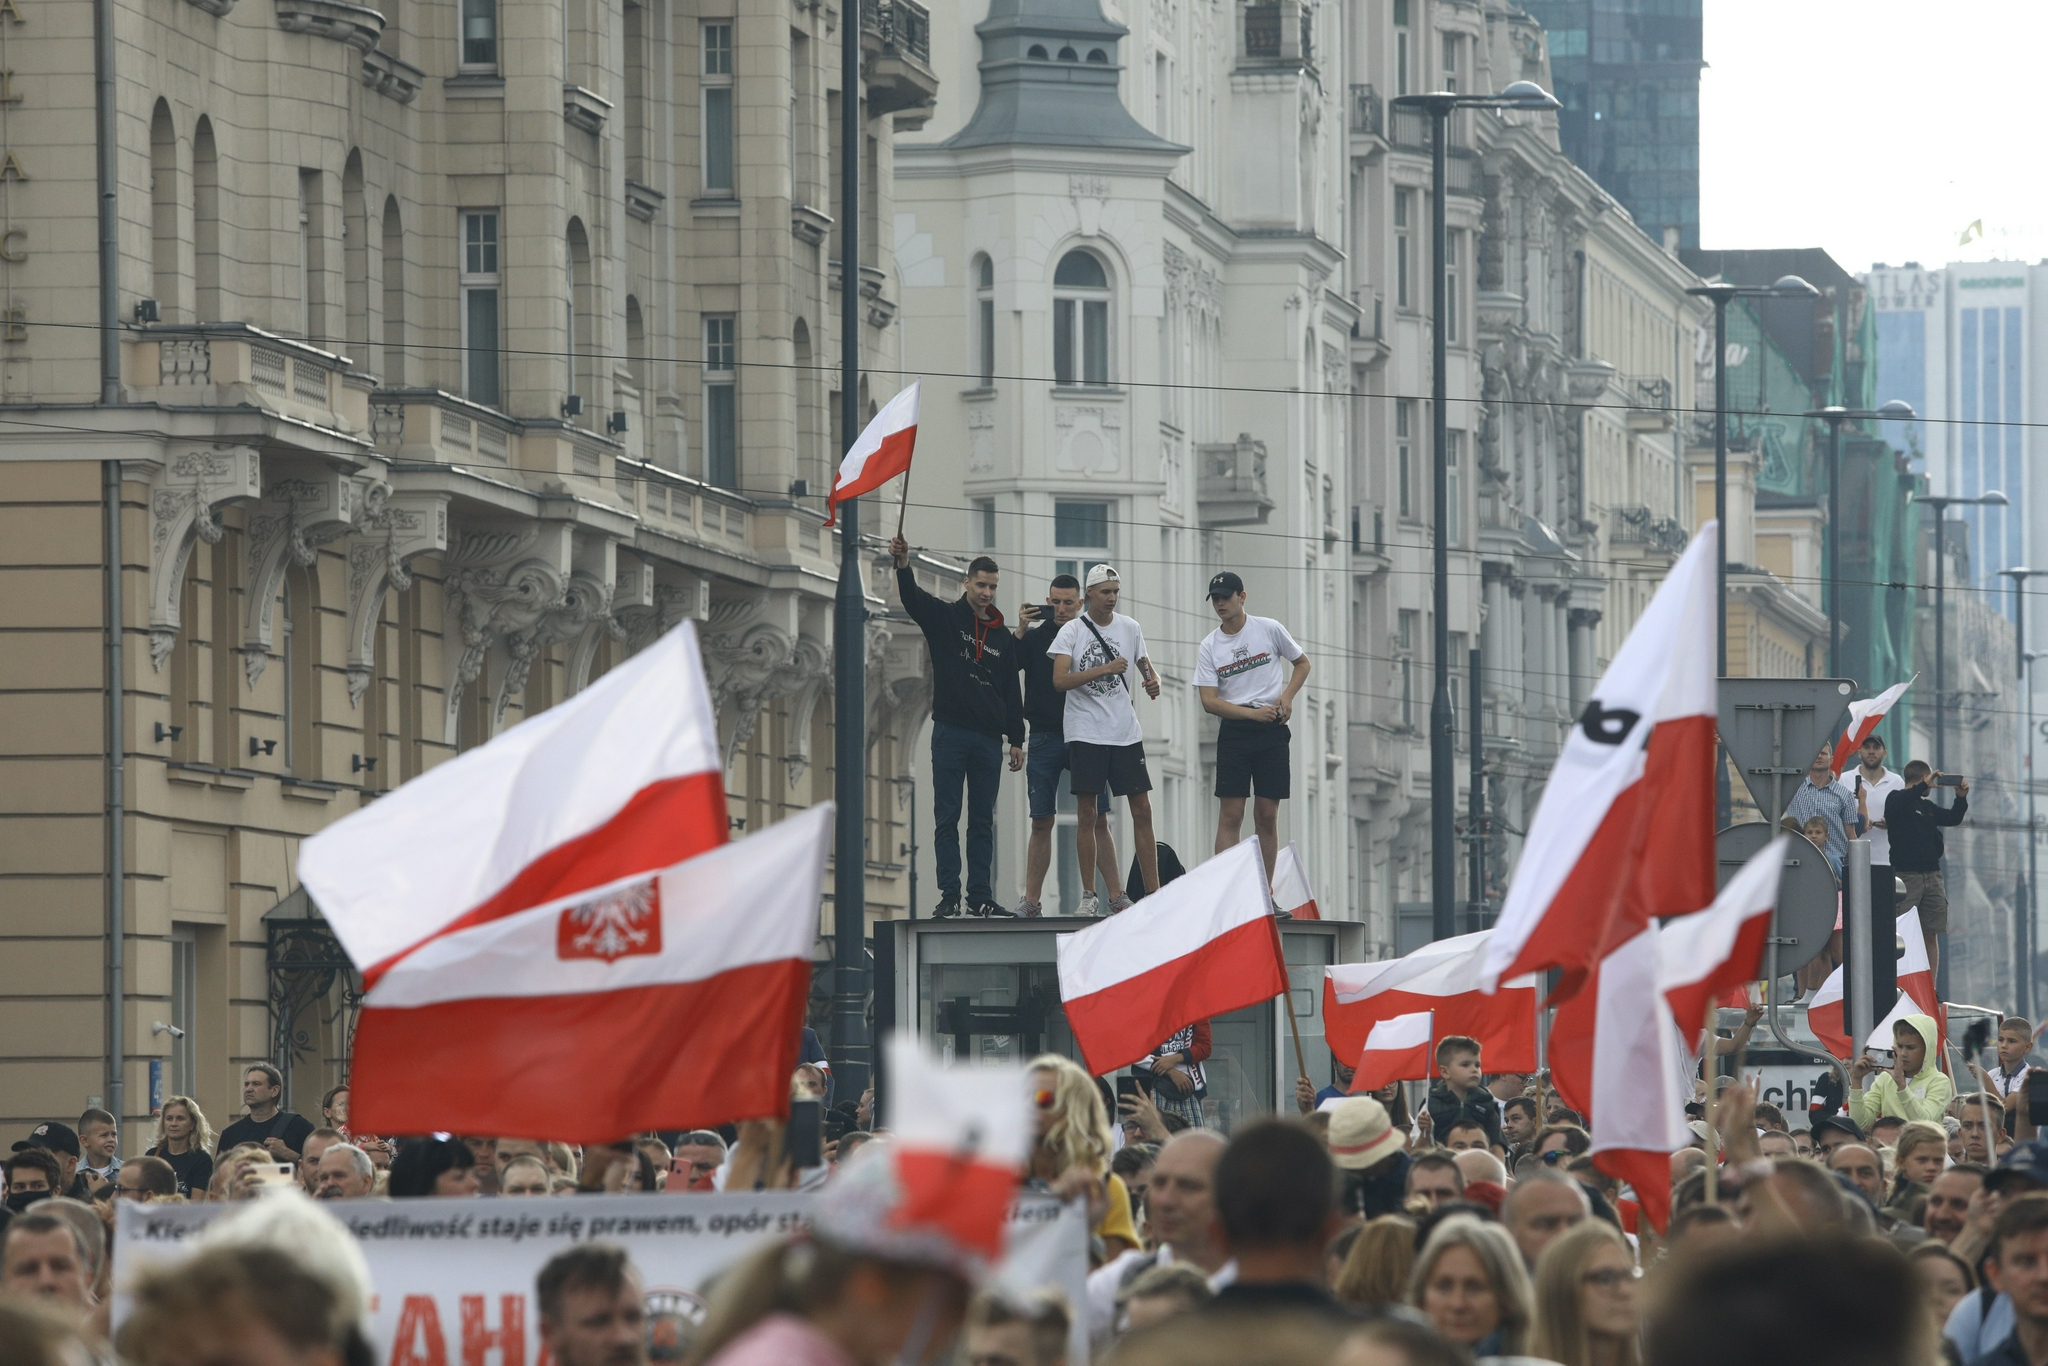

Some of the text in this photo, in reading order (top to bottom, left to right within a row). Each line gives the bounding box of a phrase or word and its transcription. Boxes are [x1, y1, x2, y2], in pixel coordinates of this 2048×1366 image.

[1877, 295, 1934, 309] OWER
[348, 1213, 474, 1240] iedliwość
[478, 1212, 542, 1243] staje
[548, 1211, 584, 1243] się
[588, 1213, 700, 1242] prawem,
[708, 1208, 771, 1241] opór
